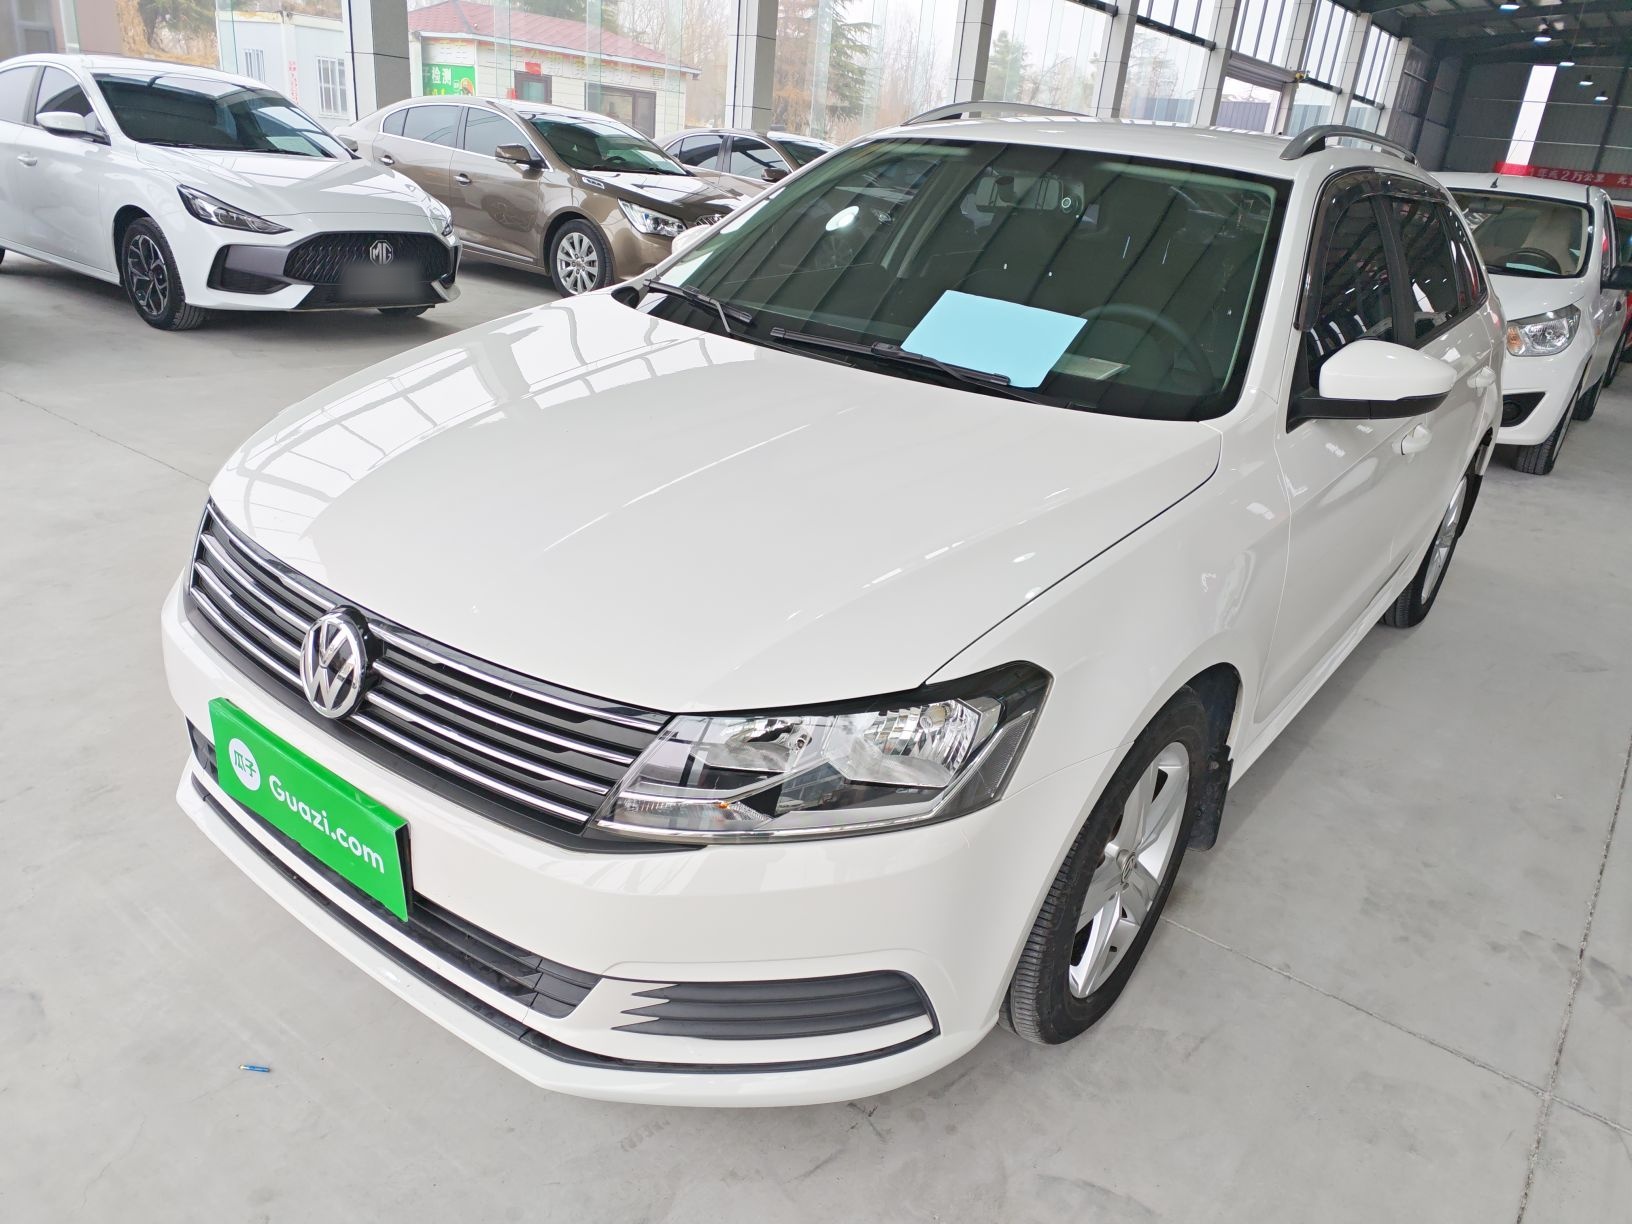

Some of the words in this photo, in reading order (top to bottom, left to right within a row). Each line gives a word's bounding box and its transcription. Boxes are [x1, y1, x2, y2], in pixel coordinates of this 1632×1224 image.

[372, 242, 392, 265] MG
[302, 612, 362, 717] VW
[233, 749, 257, 778] 瓜子
[269, 774, 384, 874] Guazi.com
